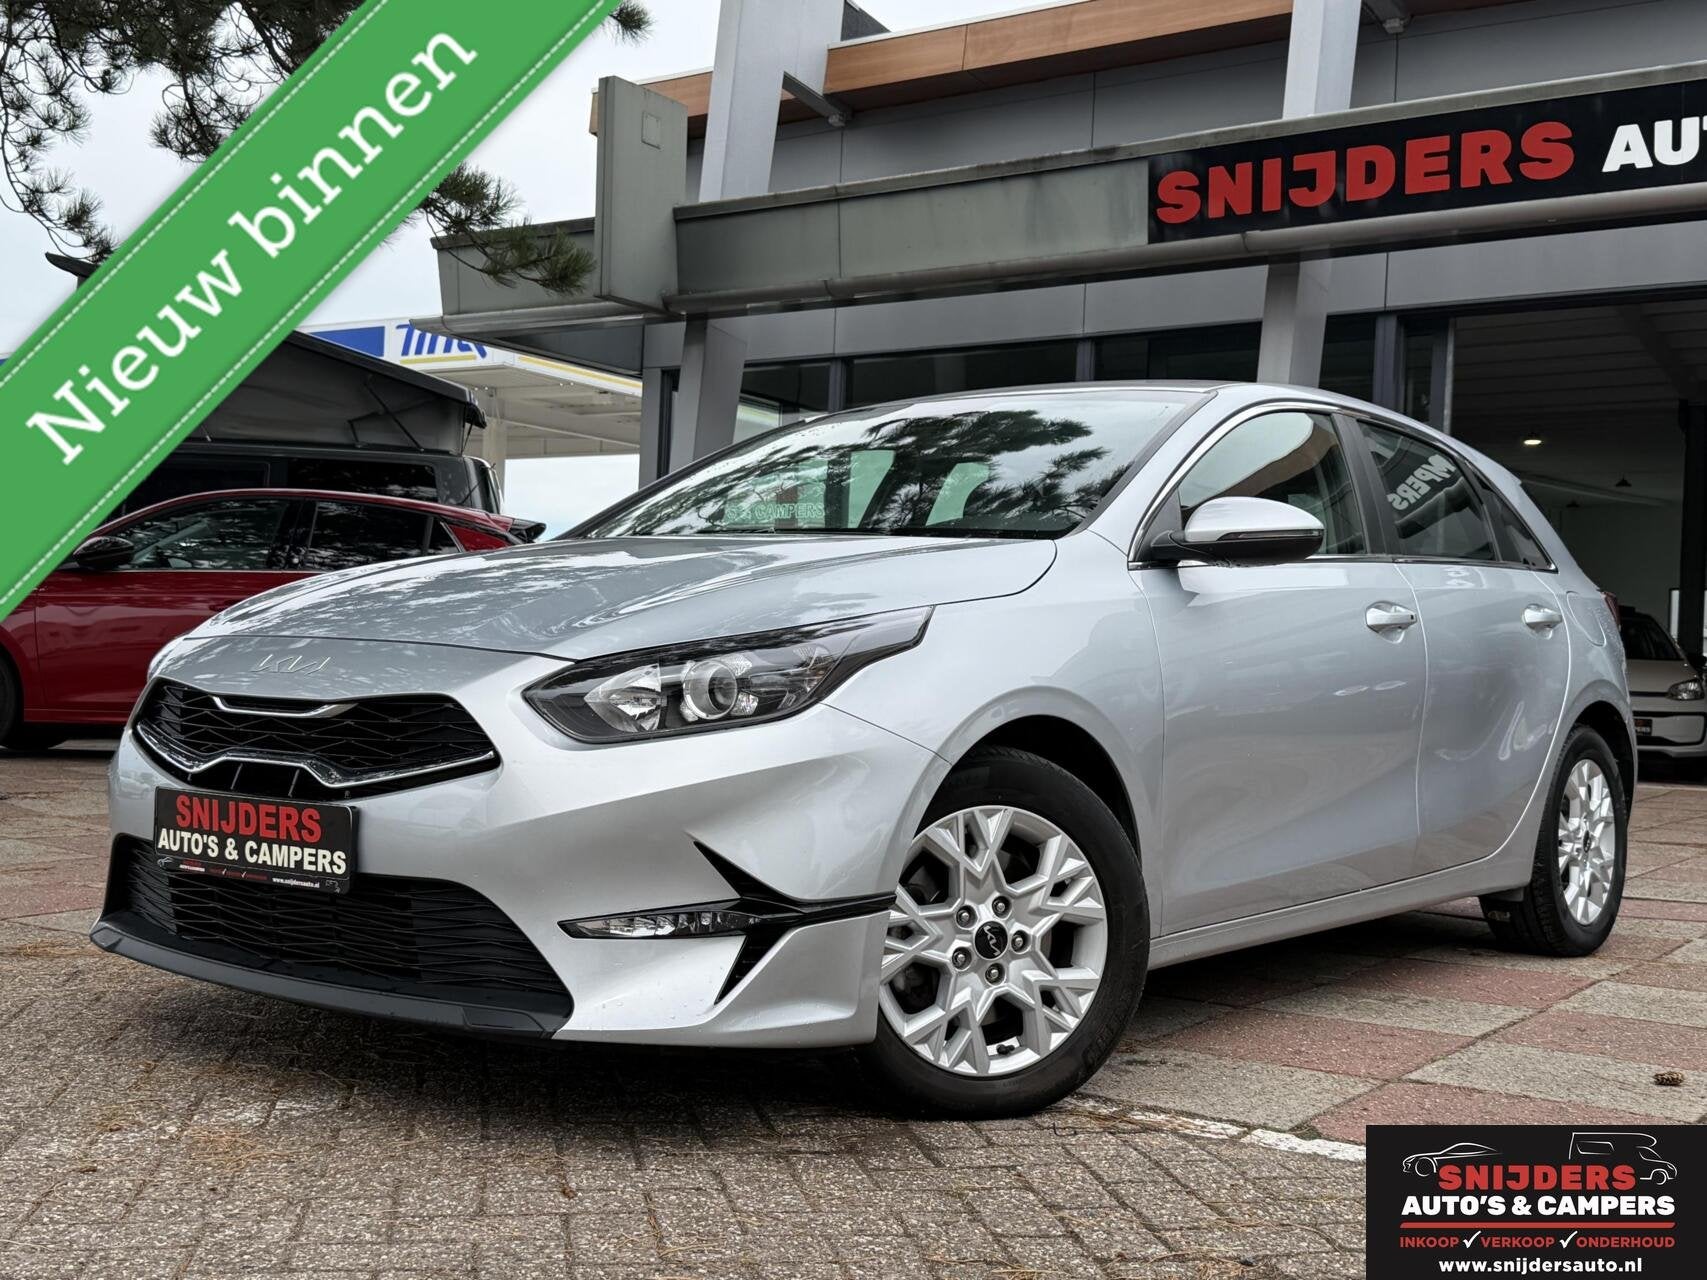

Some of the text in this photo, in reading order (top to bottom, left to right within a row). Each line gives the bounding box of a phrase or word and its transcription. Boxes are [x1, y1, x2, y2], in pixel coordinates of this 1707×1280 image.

[1156, 121, 1575, 225] SNIJDERS
[754, 502, 825, 520] CAMPERS
[176, 795, 322, 843] SNIJDERS
[157, 828, 219, 858] AUTO'S
[224, 837, 239, 861] &
[244, 840, 347, 875] CAMPERS
